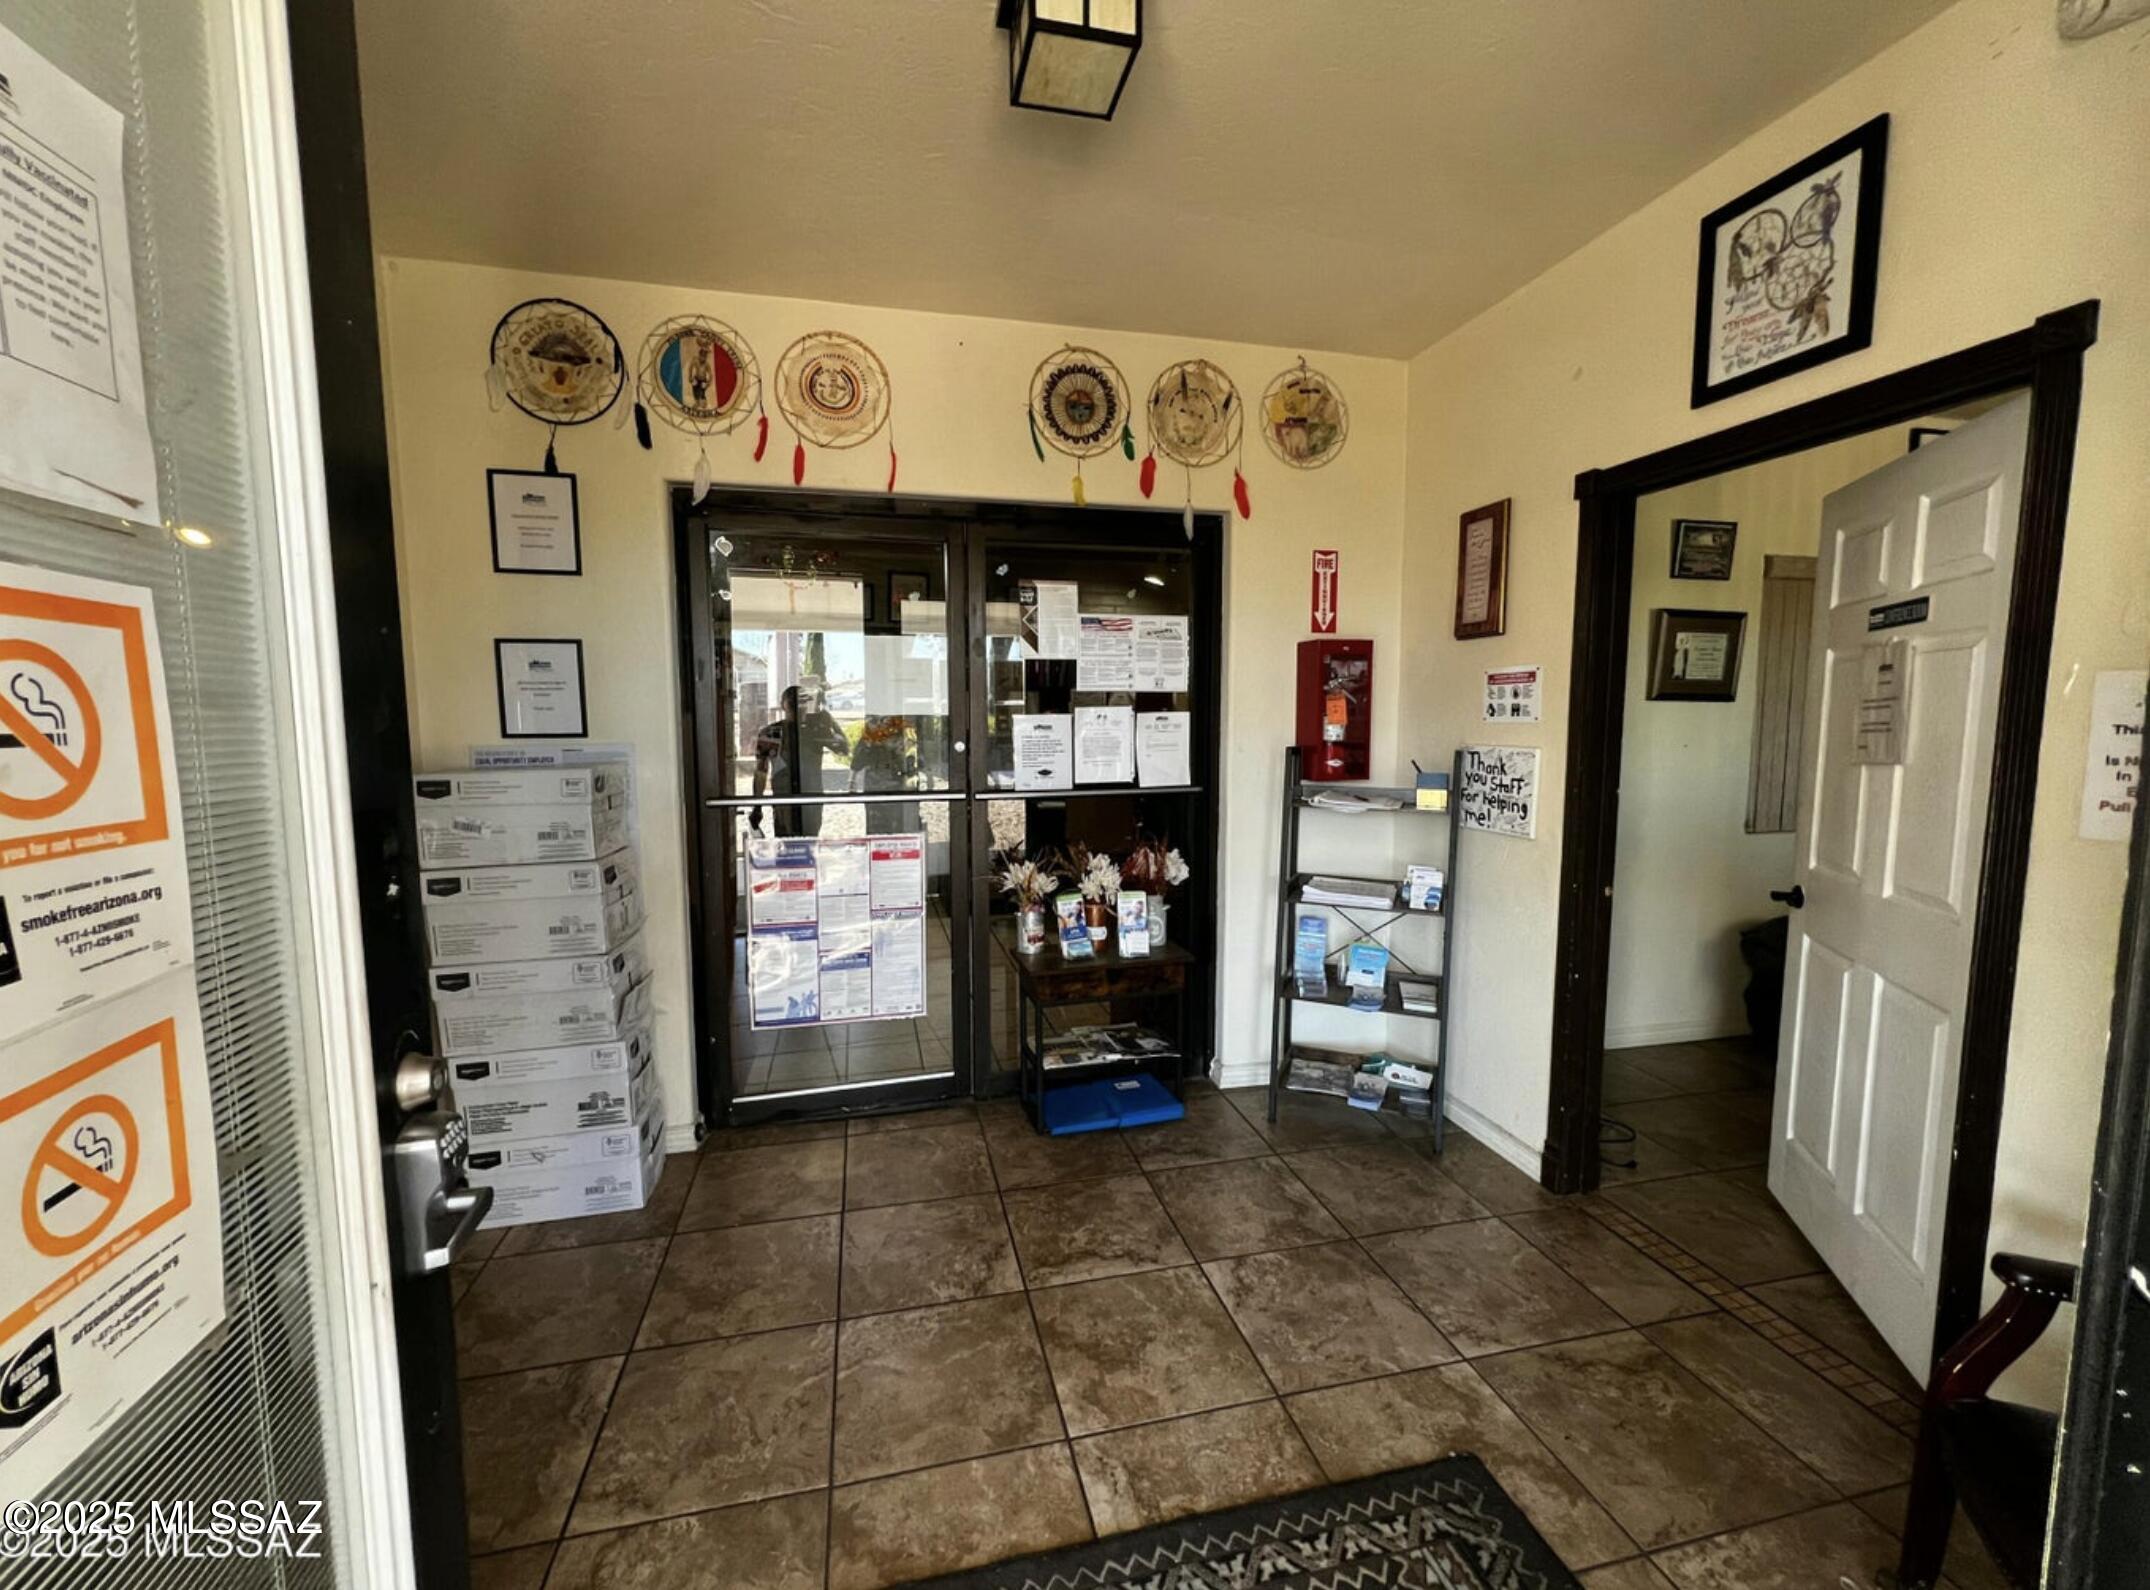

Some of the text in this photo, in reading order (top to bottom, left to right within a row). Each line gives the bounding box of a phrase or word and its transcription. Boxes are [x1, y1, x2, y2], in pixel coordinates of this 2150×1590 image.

[1316, 557, 1334, 570] FIRE
[1467, 750, 1507, 776] Thank
[1465, 771, 1488, 787] you
[1482, 790, 1529, 821] helping
[1464, 807, 1492, 829] me!
[20, 885, 163, 934] smokefreearizona.org
